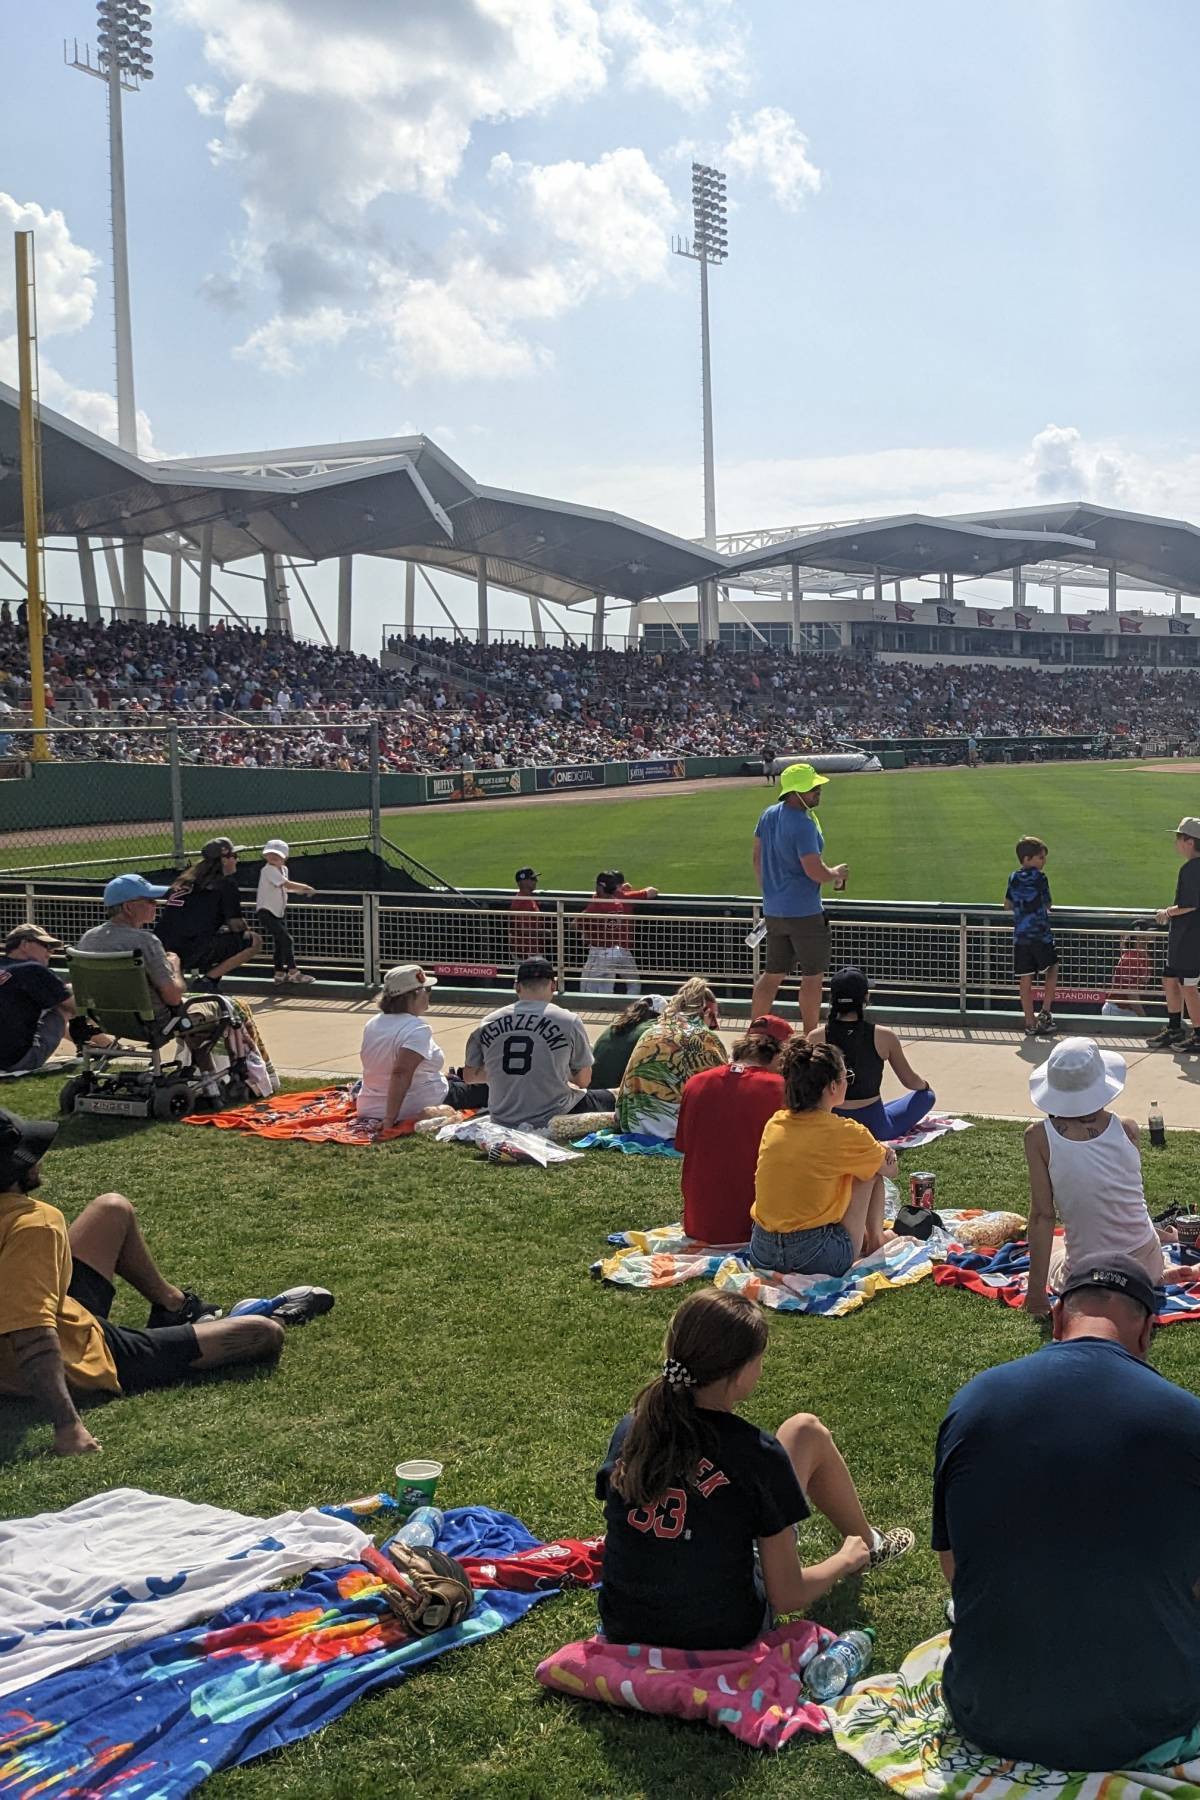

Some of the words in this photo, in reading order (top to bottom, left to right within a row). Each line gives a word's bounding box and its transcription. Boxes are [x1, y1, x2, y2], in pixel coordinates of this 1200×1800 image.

[556, 769, 596, 783] ONEDIGITAL
[438, 966, 451, 974] NO
[453, 967, 493, 976] STANDING
[1035, 991, 1046, 999] N
[1054, 991, 1101, 1001] STANDING
[480, 1014, 569, 1051] YASTRZEMSKI
[502, 1035, 535, 1076] 8
[92, 1101, 130, 1112] ZINGER
[627, 1487, 688, 1539] 33
